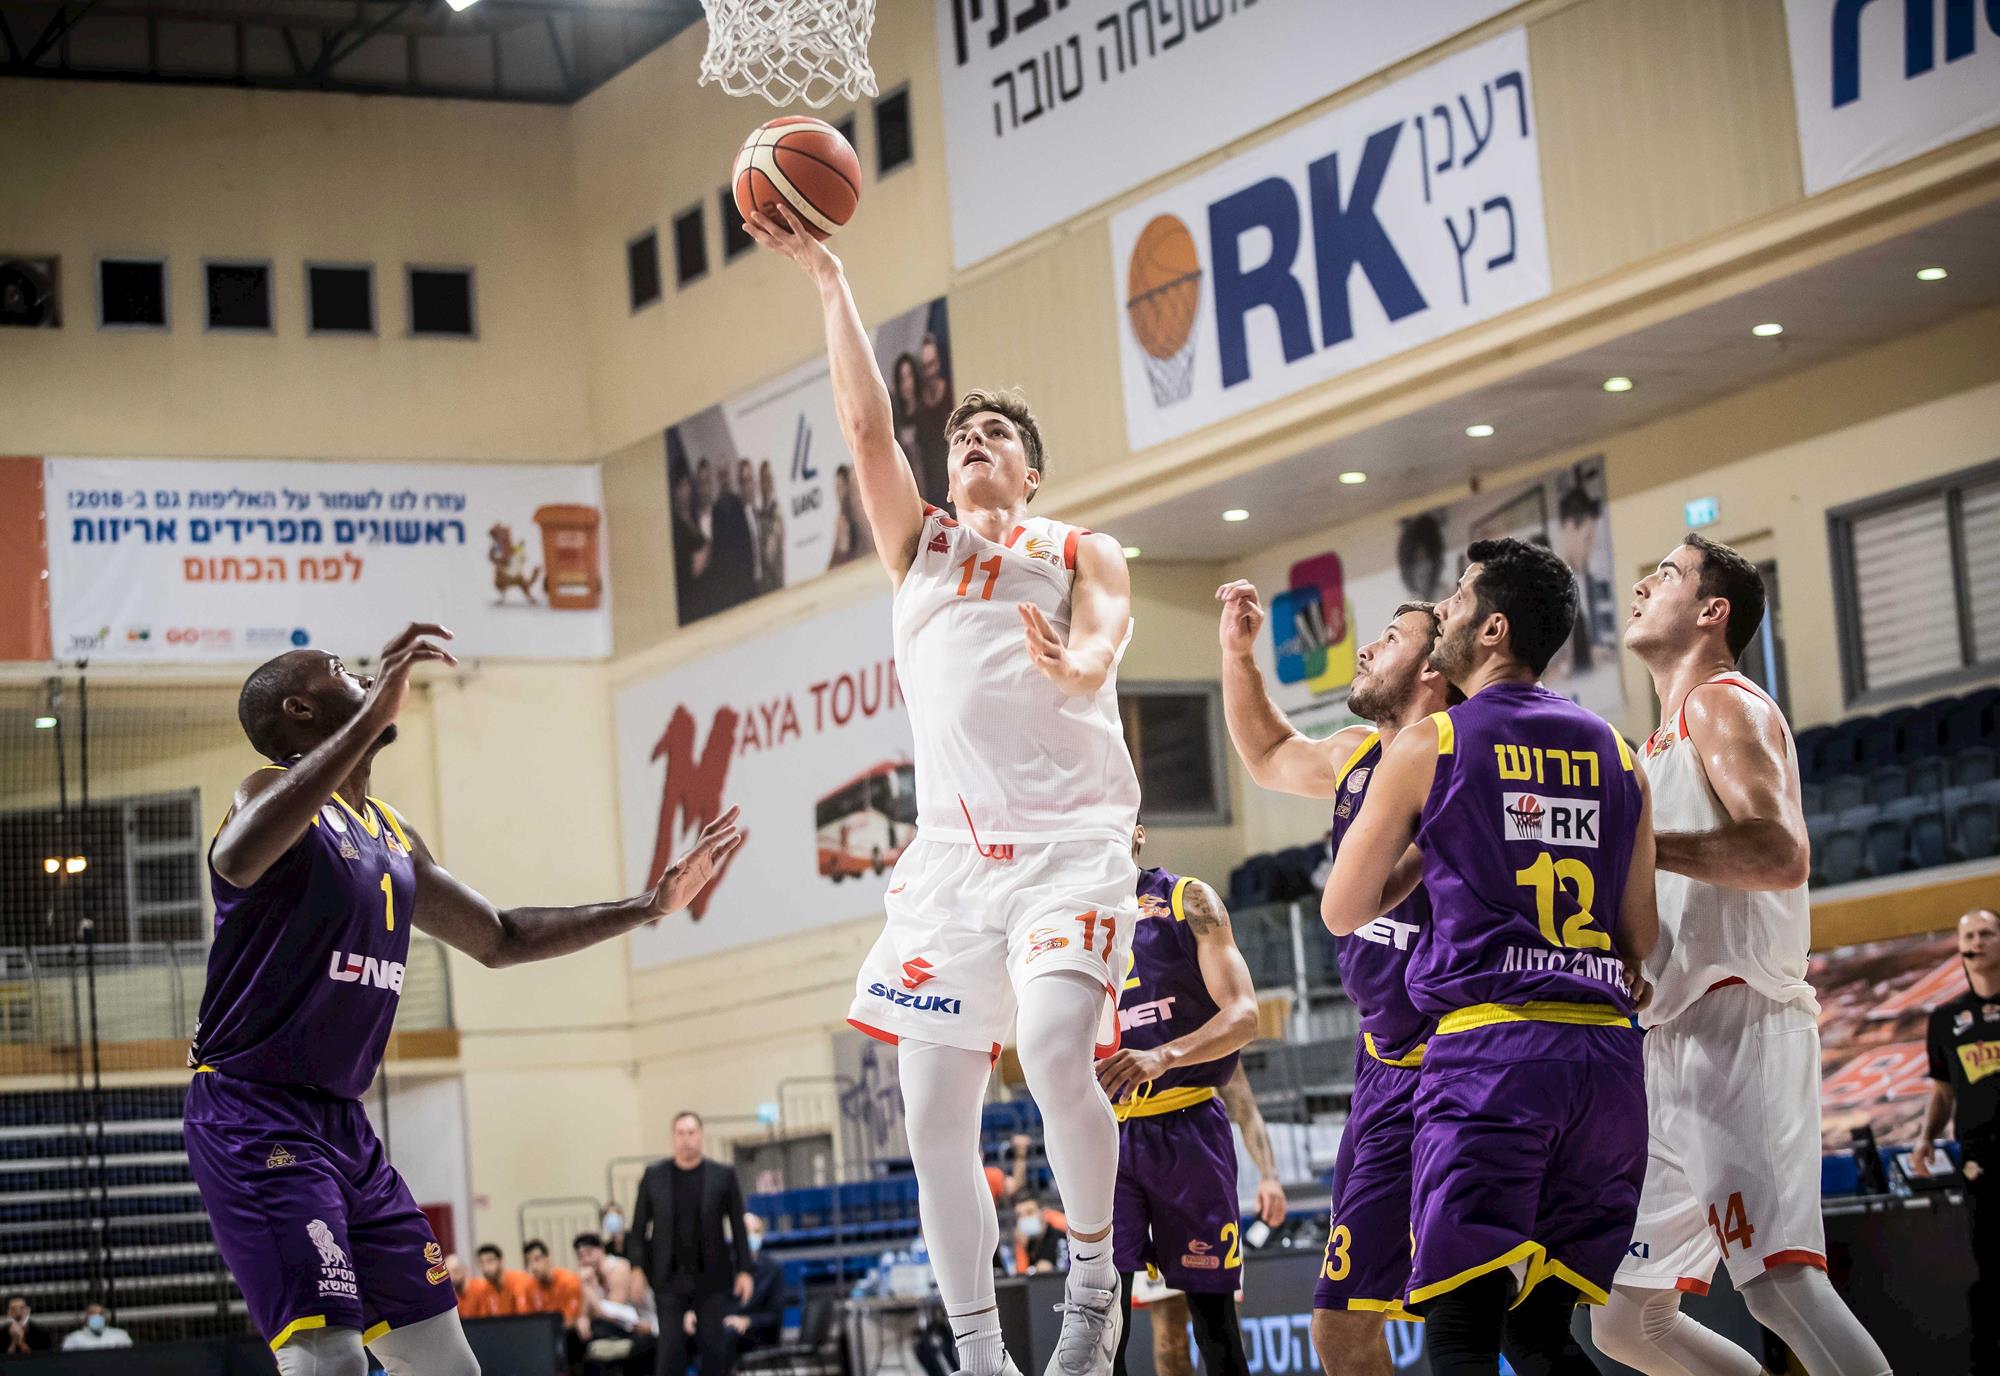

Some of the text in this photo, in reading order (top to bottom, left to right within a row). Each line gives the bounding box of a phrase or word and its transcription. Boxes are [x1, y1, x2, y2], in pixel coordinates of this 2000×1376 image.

[992, 0, 1254, 137] שפחה טובה
[1415, 70, 1530, 203] רענן
[1207, 120, 1430, 390] RK
[1443, 195, 1518, 305] כץ
[155, 489, 181, 509] גם
[281, 486, 311, 510] על
[318, 486, 384, 510] לשמור
[72, 517, 467, 544] ראשונים מפרידים אריזות
[183, 549, 363, 582] לפח הכתום
[956, 553, 1003, 601] 11
[1494, 743, 1600, 788] הרוש
[1550, 805, 1598, 843] RK
[380, 872, 395, 932] 1
[1515, 851, 1612, 951] 12
[1074, 910, 1117, 965] 11
[328, 950, 407, 997] UNE
[867, 982, 962, 1015] SUZUKI
[1707, 1191, 1756, 1260] 14
